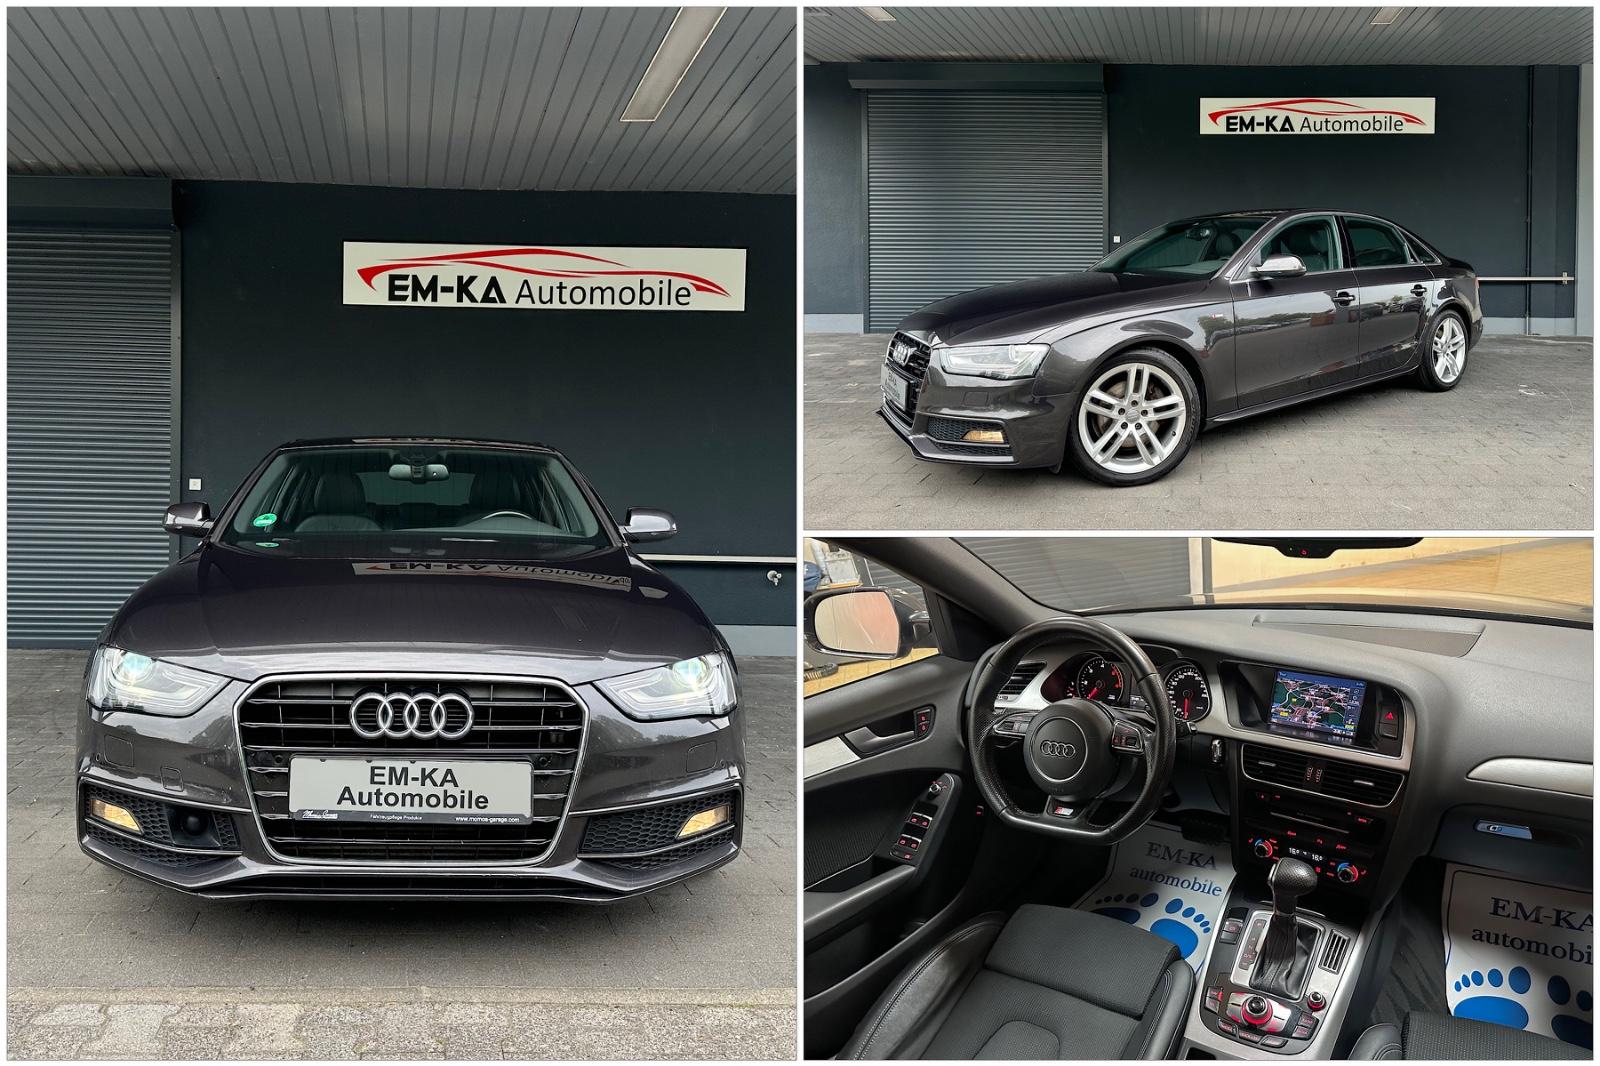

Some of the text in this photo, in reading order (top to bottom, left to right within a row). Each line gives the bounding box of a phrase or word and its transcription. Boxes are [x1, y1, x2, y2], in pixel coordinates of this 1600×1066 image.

[1225, 115, 1403, 133] EM-KA Automobile
[387, 273, 692, 307] EM-KA Automobile
[369, 765, 459, 788] EM-KA
[336, 785, 489, 810] Automobile
[1145, 842, 1217, 870] EM-KA
[1130, 866, 1222, 896] automobile
